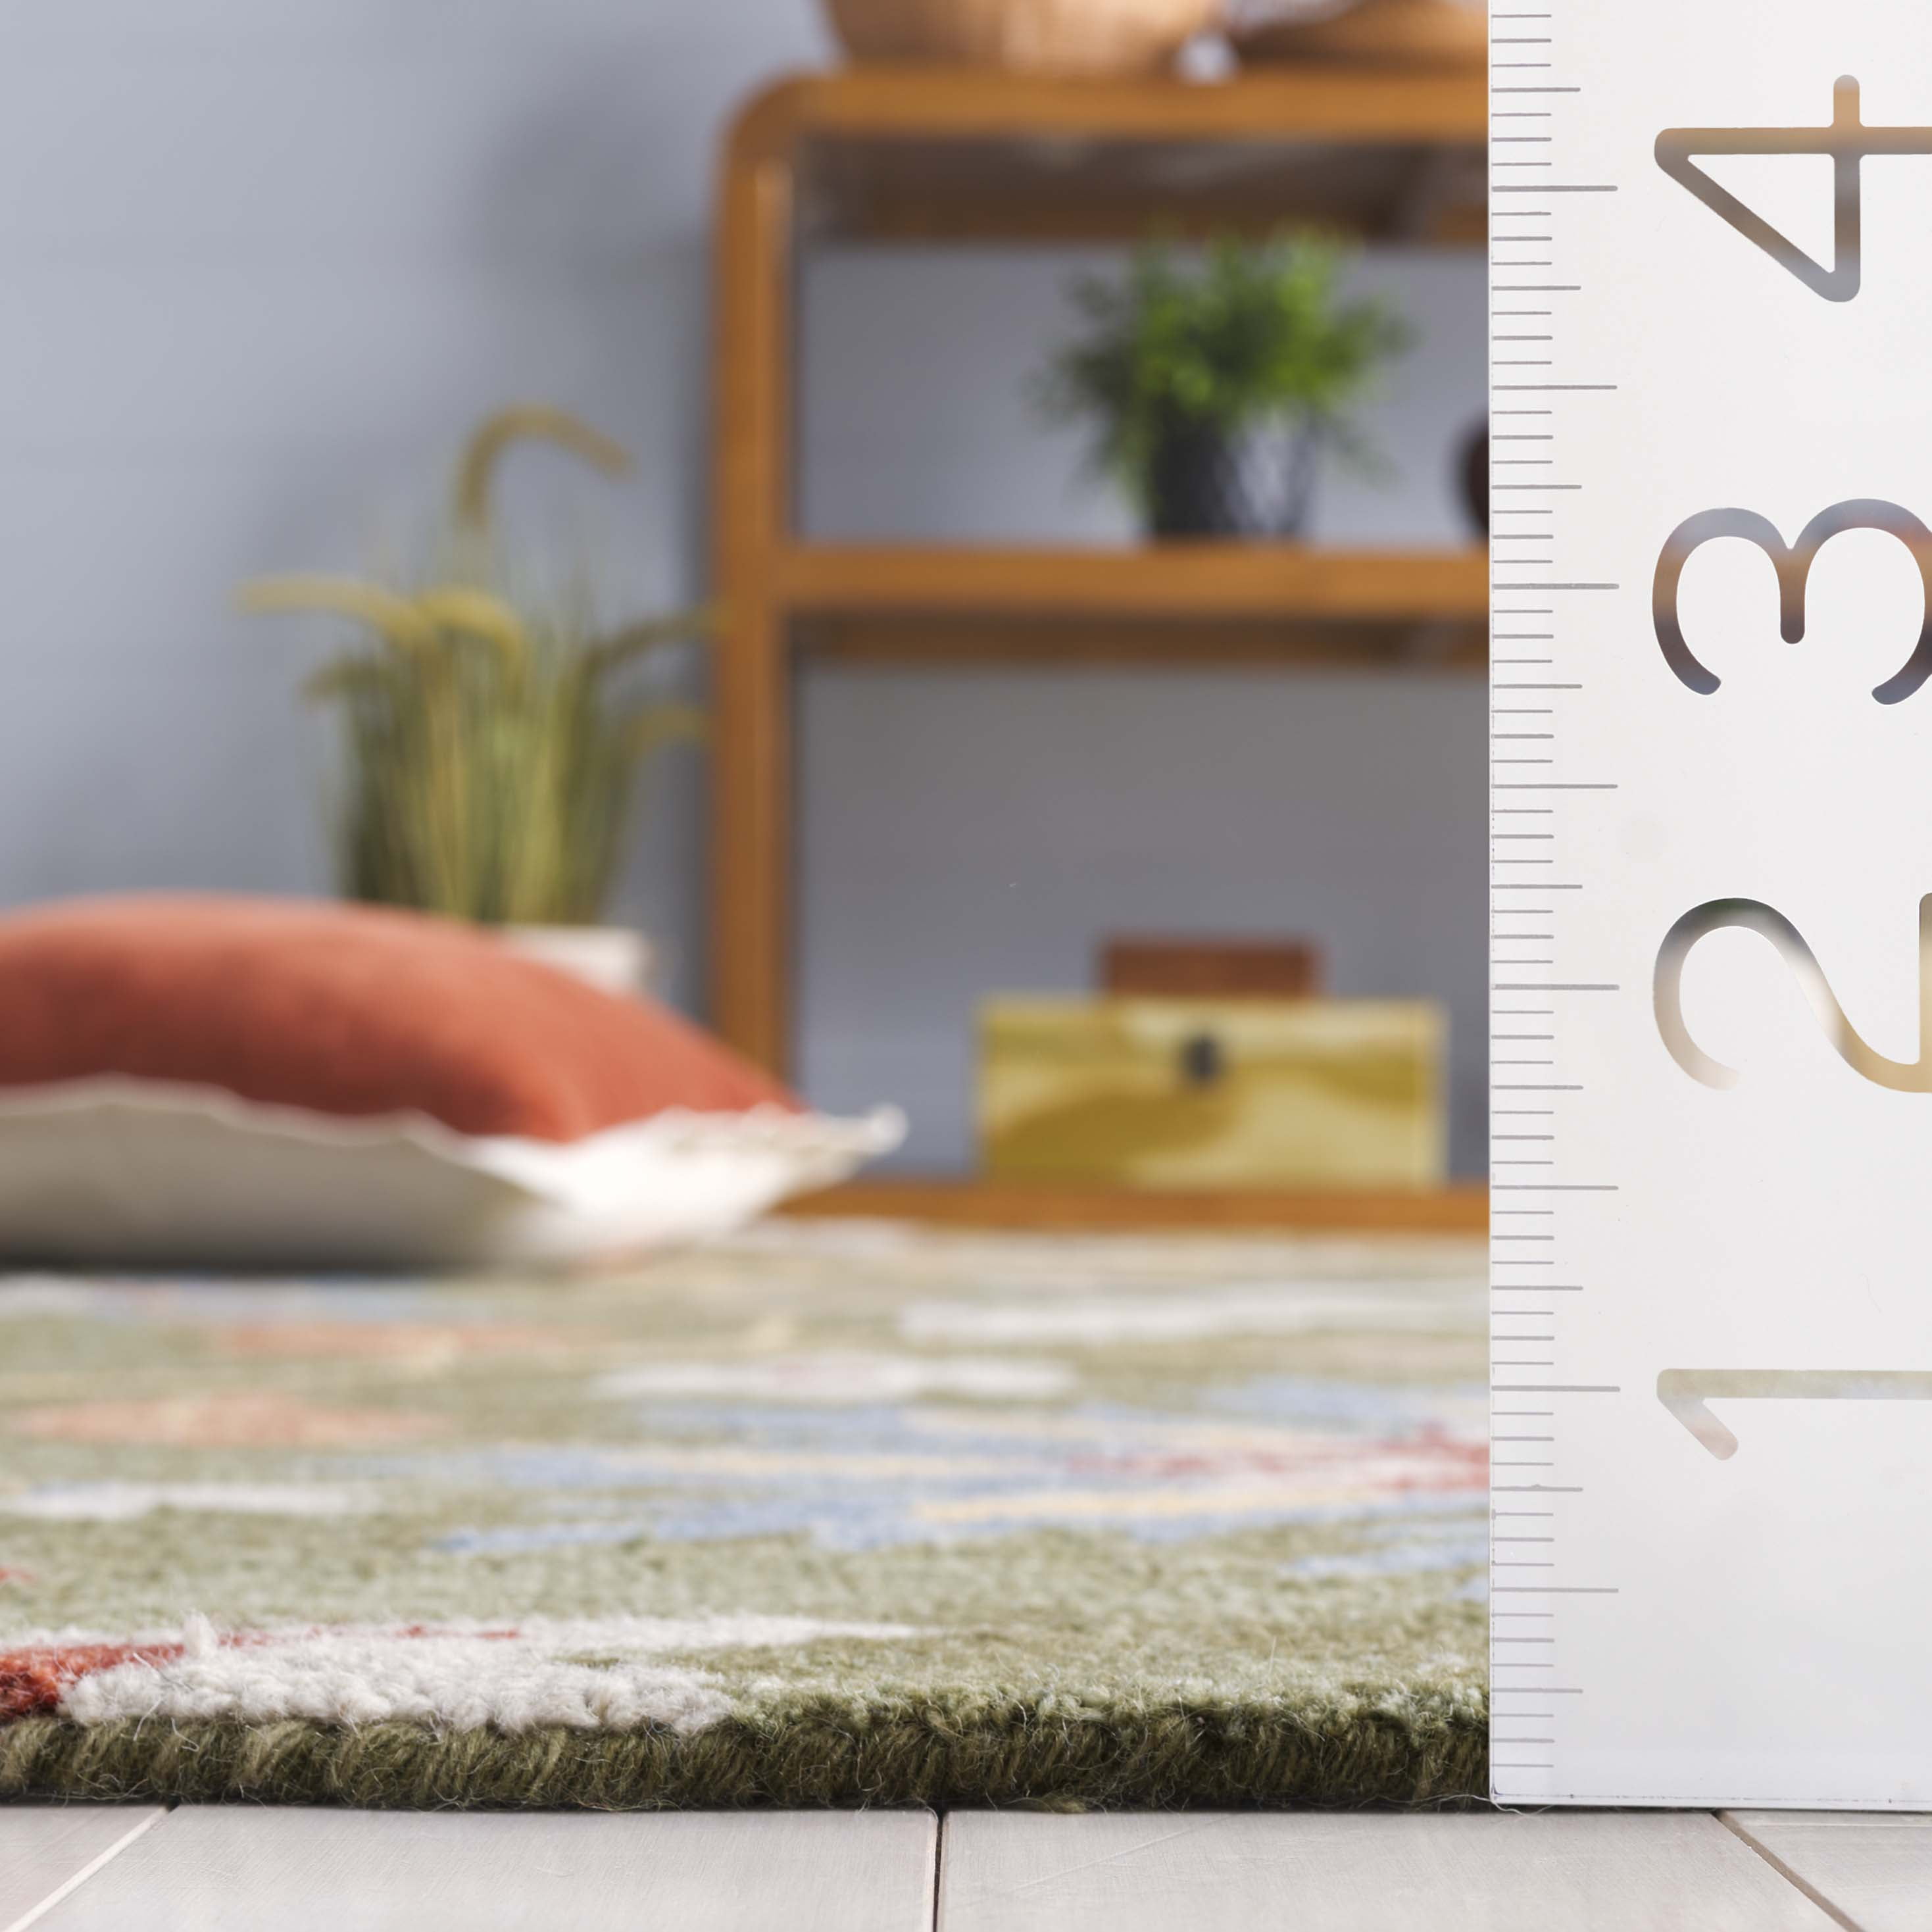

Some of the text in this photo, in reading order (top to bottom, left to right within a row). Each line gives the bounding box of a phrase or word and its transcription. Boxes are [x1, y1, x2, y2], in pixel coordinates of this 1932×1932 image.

[1654, 74, 1932, 303] 4
[1652, 498, 1932, 705] 3
[1652, 893, 1932, 1093] 2
[1656, 1368, 1932, 1460] 1
